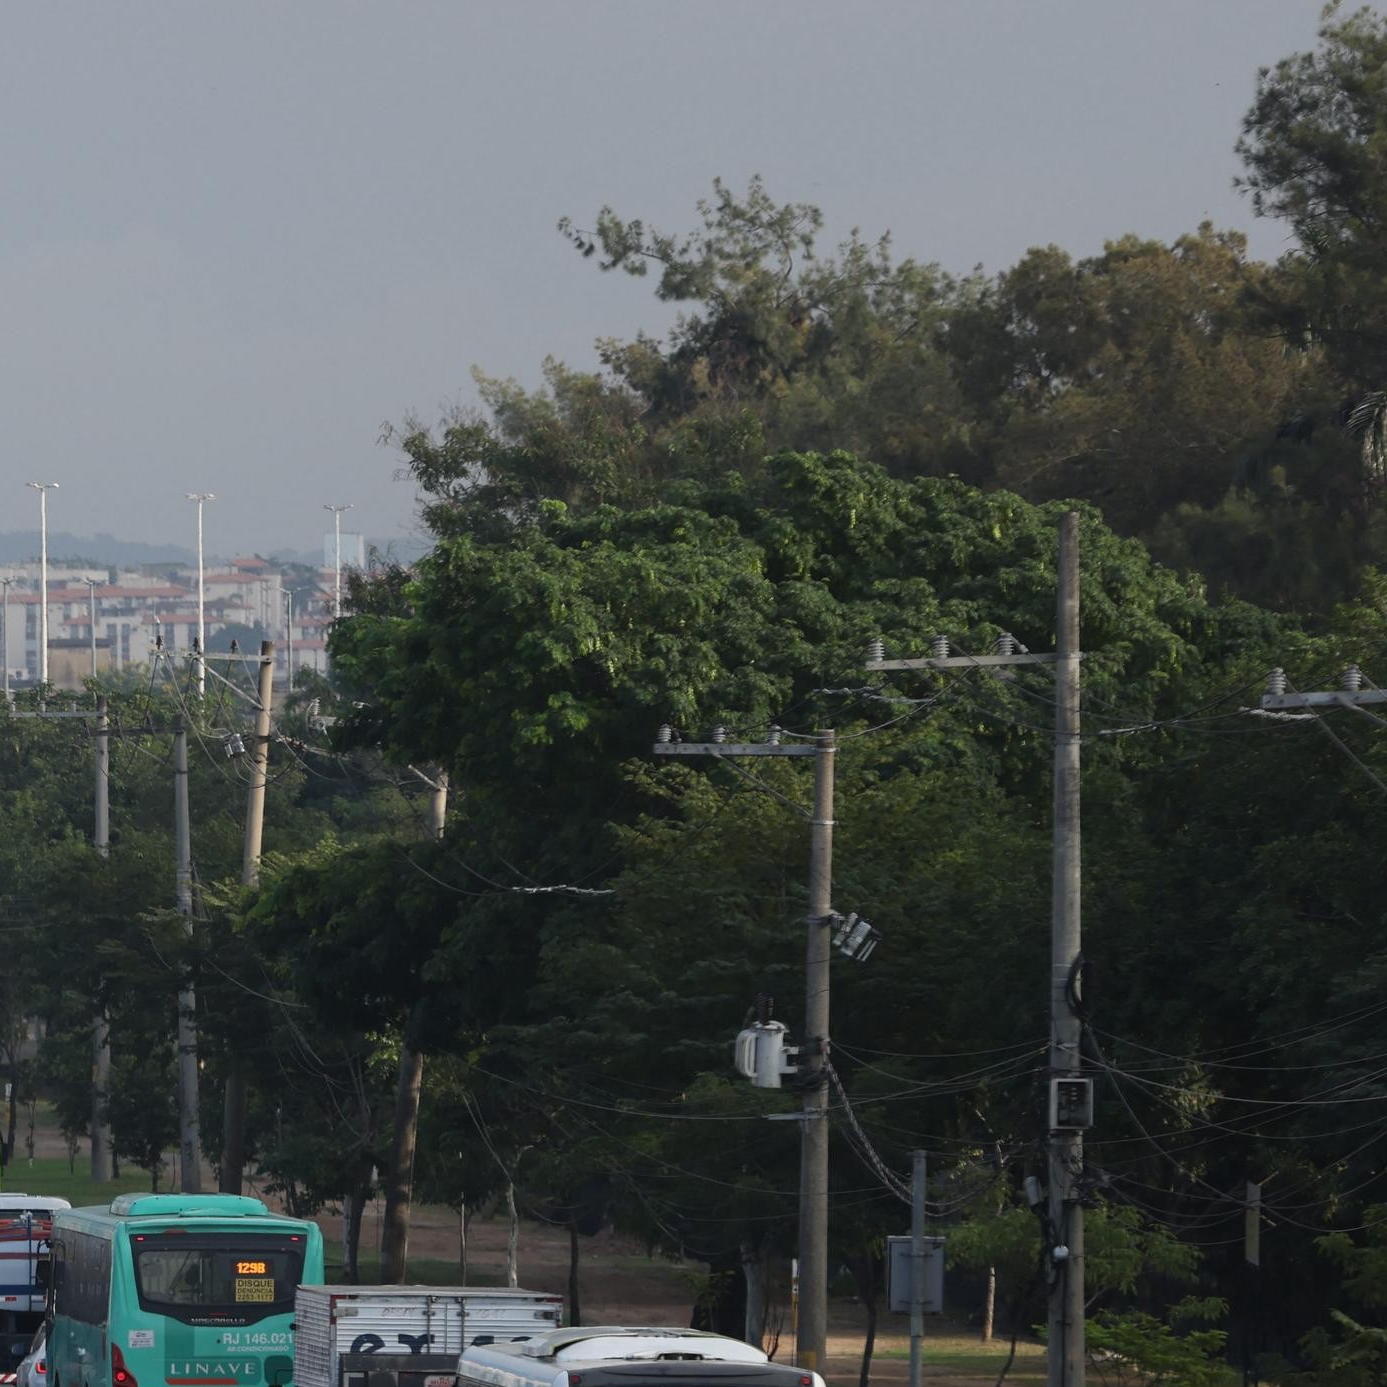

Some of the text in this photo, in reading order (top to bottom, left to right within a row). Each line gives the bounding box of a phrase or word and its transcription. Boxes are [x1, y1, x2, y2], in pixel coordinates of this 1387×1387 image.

[236, 1262, 266, 1274] 129B
[237, 1280, 273, 1288] DISQUE
[223, 1332, 293, 1345] RJ 146.021
[170, 1362, 256, 1375] LINAVE
